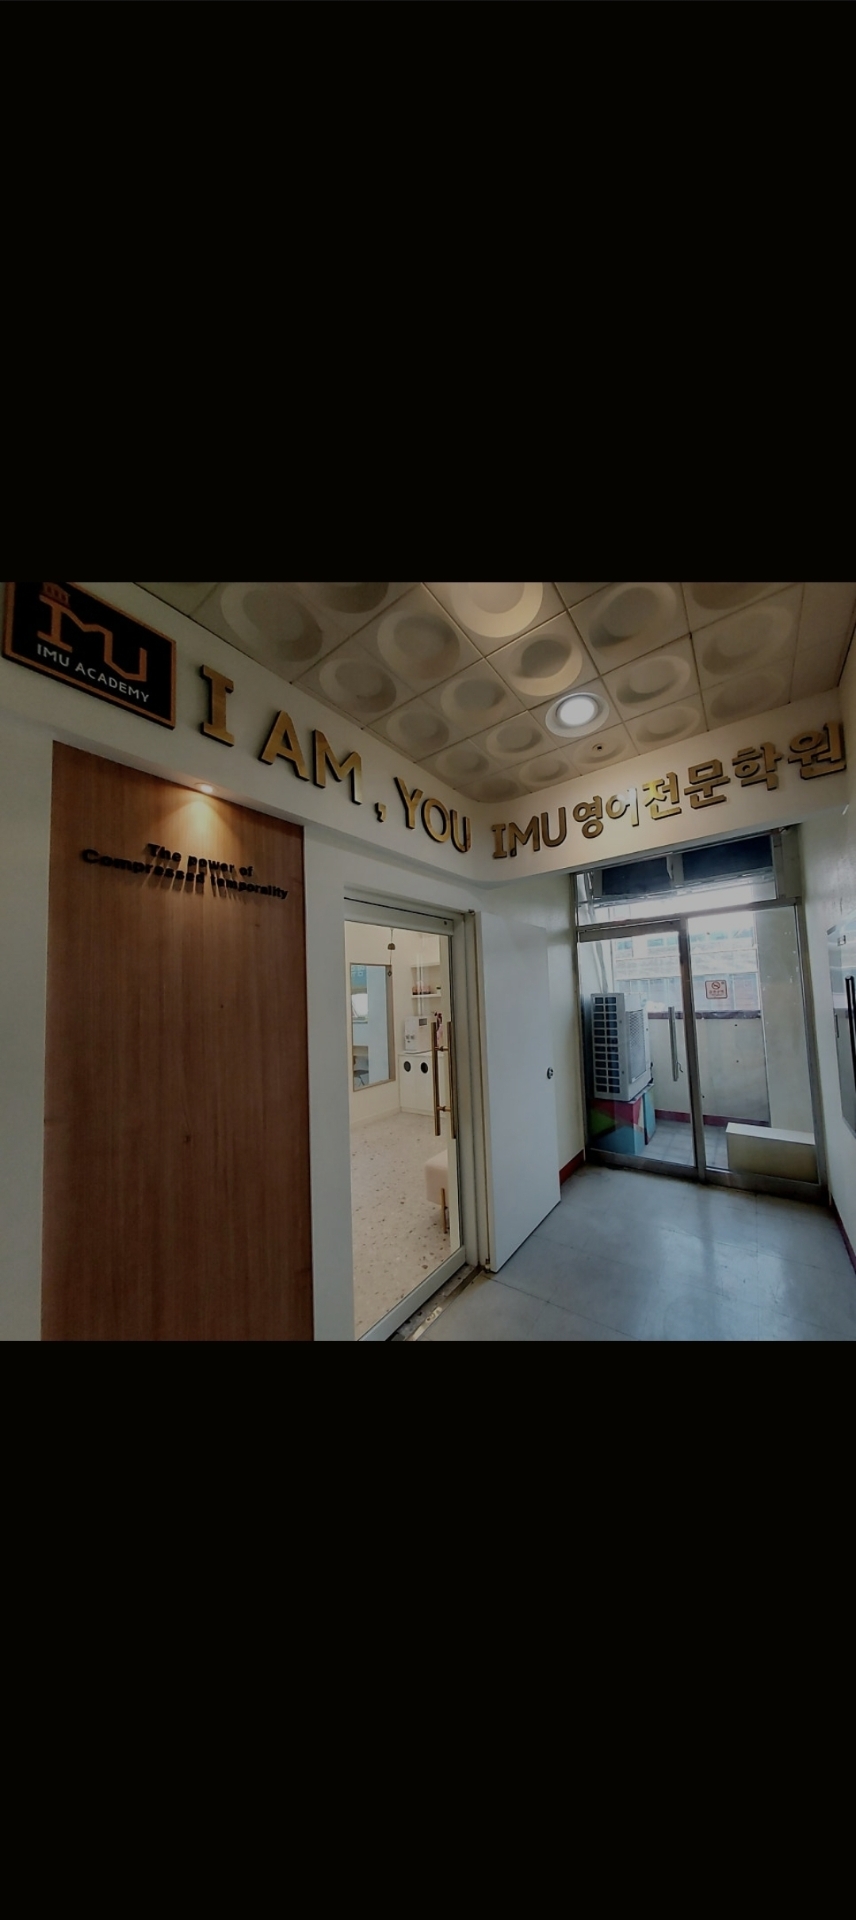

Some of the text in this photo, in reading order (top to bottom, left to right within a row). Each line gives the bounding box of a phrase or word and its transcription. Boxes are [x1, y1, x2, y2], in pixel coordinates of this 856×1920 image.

[37, 643, 149, 702] IMU ACADEMY
[200, 664, 234, 747] I
[394, 776, 471, 853] YOU
[491, 721, 847, 858] IMU 영어전문학원
[82, 848, 288, 900] Compressed temporality
[148, 843, 253, 877] The power of
